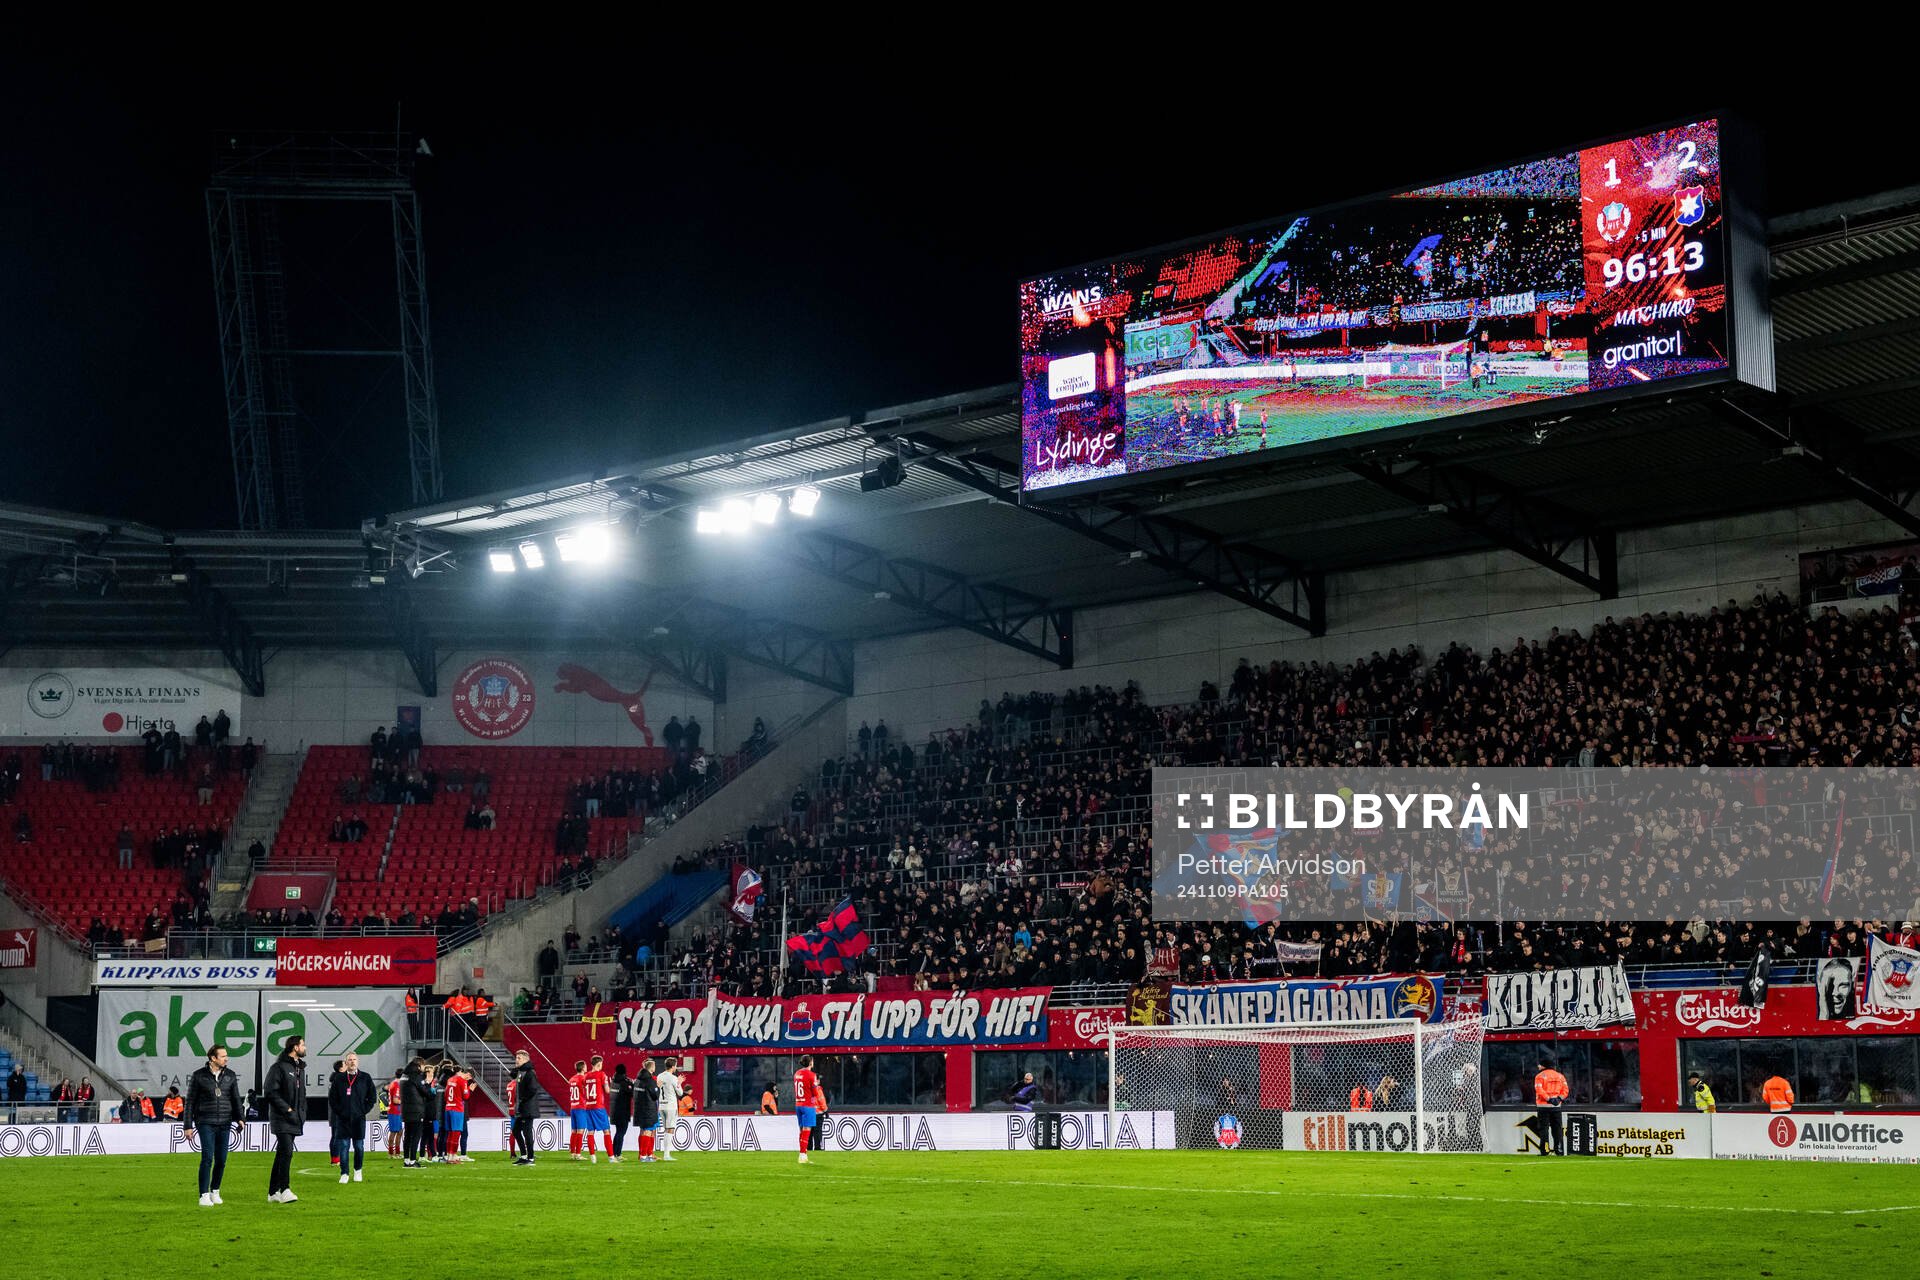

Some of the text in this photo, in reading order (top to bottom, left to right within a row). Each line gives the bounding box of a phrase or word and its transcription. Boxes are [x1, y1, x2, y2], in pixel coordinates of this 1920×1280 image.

[1604, 140, 1698, 187] 1 2
[1651, 226, 1667, 240] MIN
[1602, 241, 1704, 288] 96:13
[1043, 285, 1101, 313] WANS
[1036, 430, 1116, 473] Lydinge
[77, 687, 201, 697] SVENSKA FINANS
[277, 951, 391, 972] HÖGERSVÄNGEN
[1158, 949, 1177, 965] HIF
[101, 966, 201, 979] KLIPPANS
[206, 966, 259, 979] BUSS
[1171, 981, 1388, 1025] SKÅNEPÅGARNA
[1675, 994, 1761, 1027] Carlsberg
[117, 995, 306, 1058] akea
[616, 1003, 714, 1047] SÖDRA
[817, 994, 866, 1040] STÅ
[870, 999, 922, 1040] UPP
[926, 990, 980, 1040] FÖR
[984, 994, 1045, 1037] HIF!
[447, 1086, 454, 1102] 9
[569, 1086, 580, 1101] 20
[585, 1083, 597, 1100] 14
[794, 1080, 805, 1098] 16
[0, 1125, 107, 1158] OOLIA
[821, 1115, 937, 1151] POOLIA
[1572, 1122, 1580, 1152] SELECT
[1617, 1127, 1685, 1141] Plåtslageri
[1799, 1122, 1904, 1144] AllOffice
[1597, 1144, 1674, 1158] singborg AB
[1836, 1143, 1878, 1151] leverantör!
